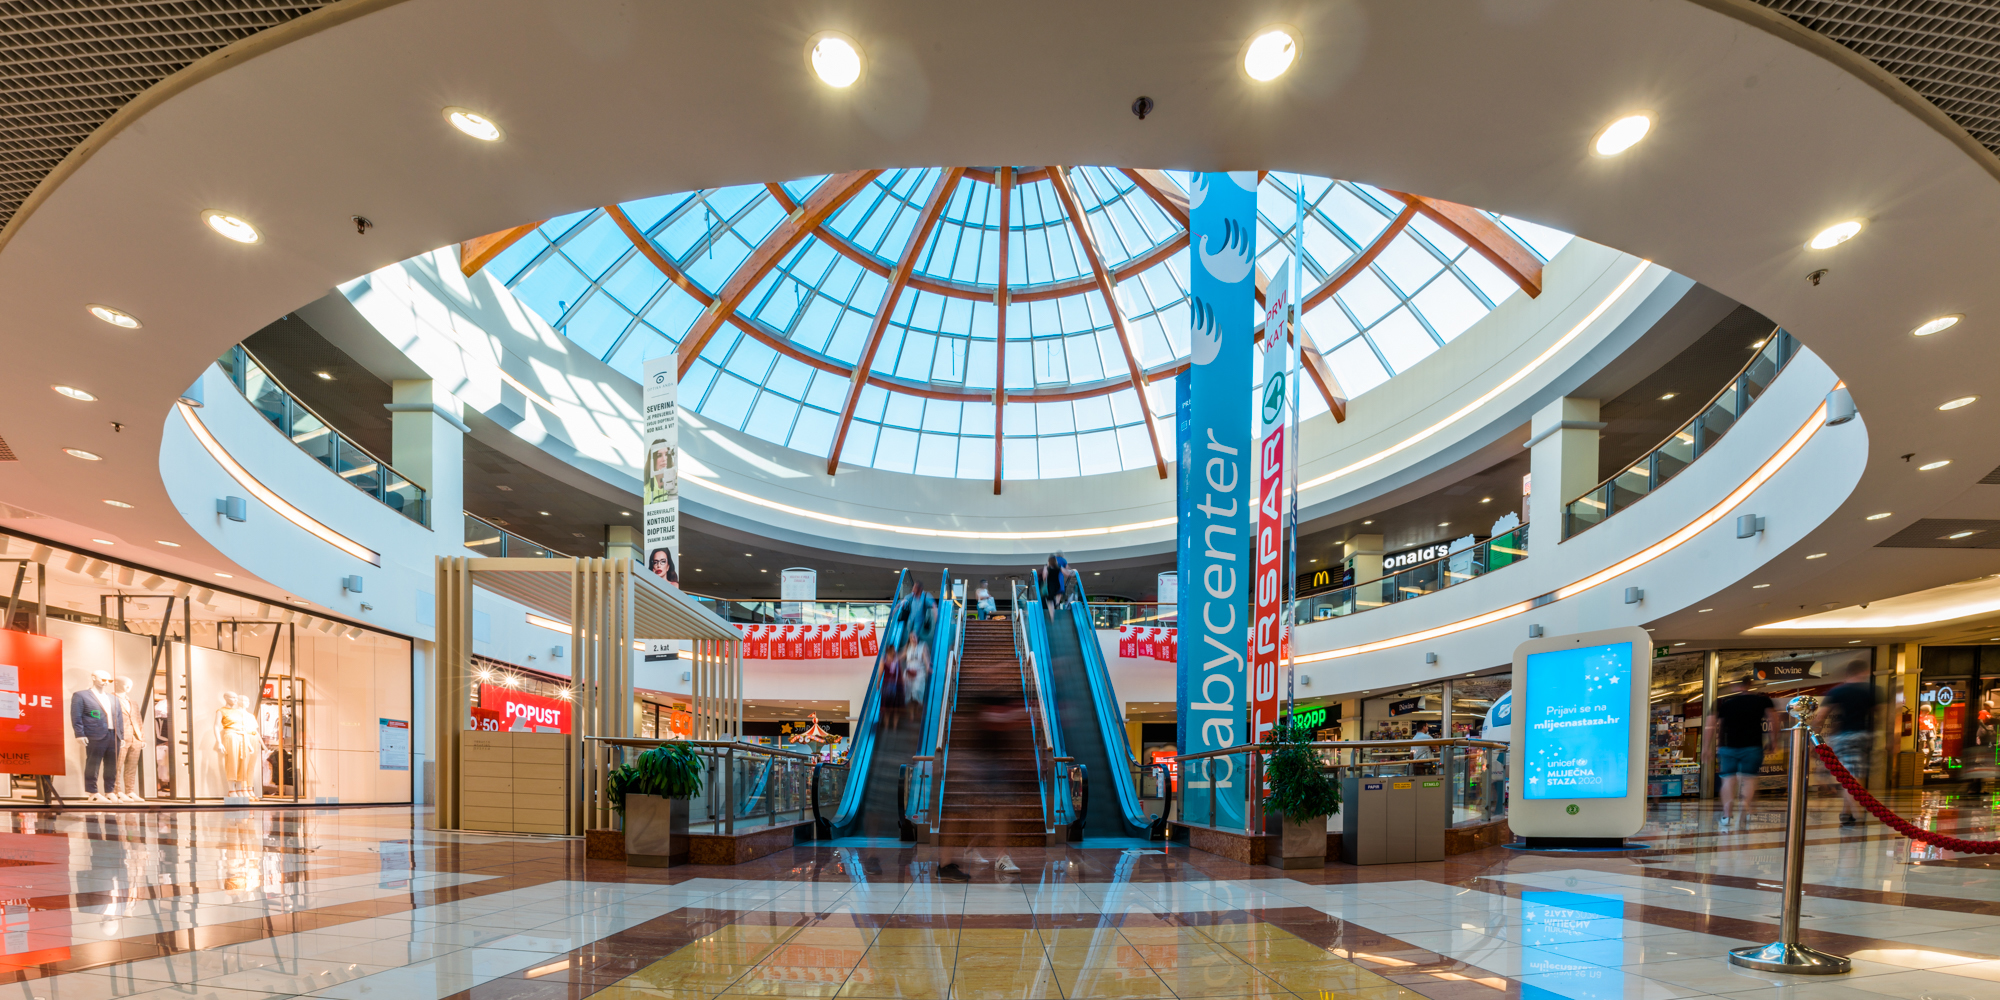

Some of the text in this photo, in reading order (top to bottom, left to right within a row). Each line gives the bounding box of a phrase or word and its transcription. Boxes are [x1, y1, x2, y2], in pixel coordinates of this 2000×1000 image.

[1266, 289, 1287, 327] PRVI
[1266, 319, 1285, 353] KAT
[646, 400, 675, 414] SEVERINA
[652, 409, 675, 420] PROVJERILA
[646, 515, 675, 526] KONTROLU
[646, 525, 675, 536] DIOPTRIJE
[1382, 545, 1449, 569] onald's
[1188, 427, 1244, 789] babycenter
[1254, 431, 1281, 793] TERSPAR
[653, 644, 659, 652] 2.
[506, 701, 561, 726] POPUST
[1546, 703, 1607, 718] Prijavi se na
[1533, 715, 1620, 732] mlijecnastaza.hr
[1547, 759, 1576, 768] unicef
[1547, 768, 1595, 778] MLIJEČNA
[1547, 776, 1602, 786] STAZA 2020
